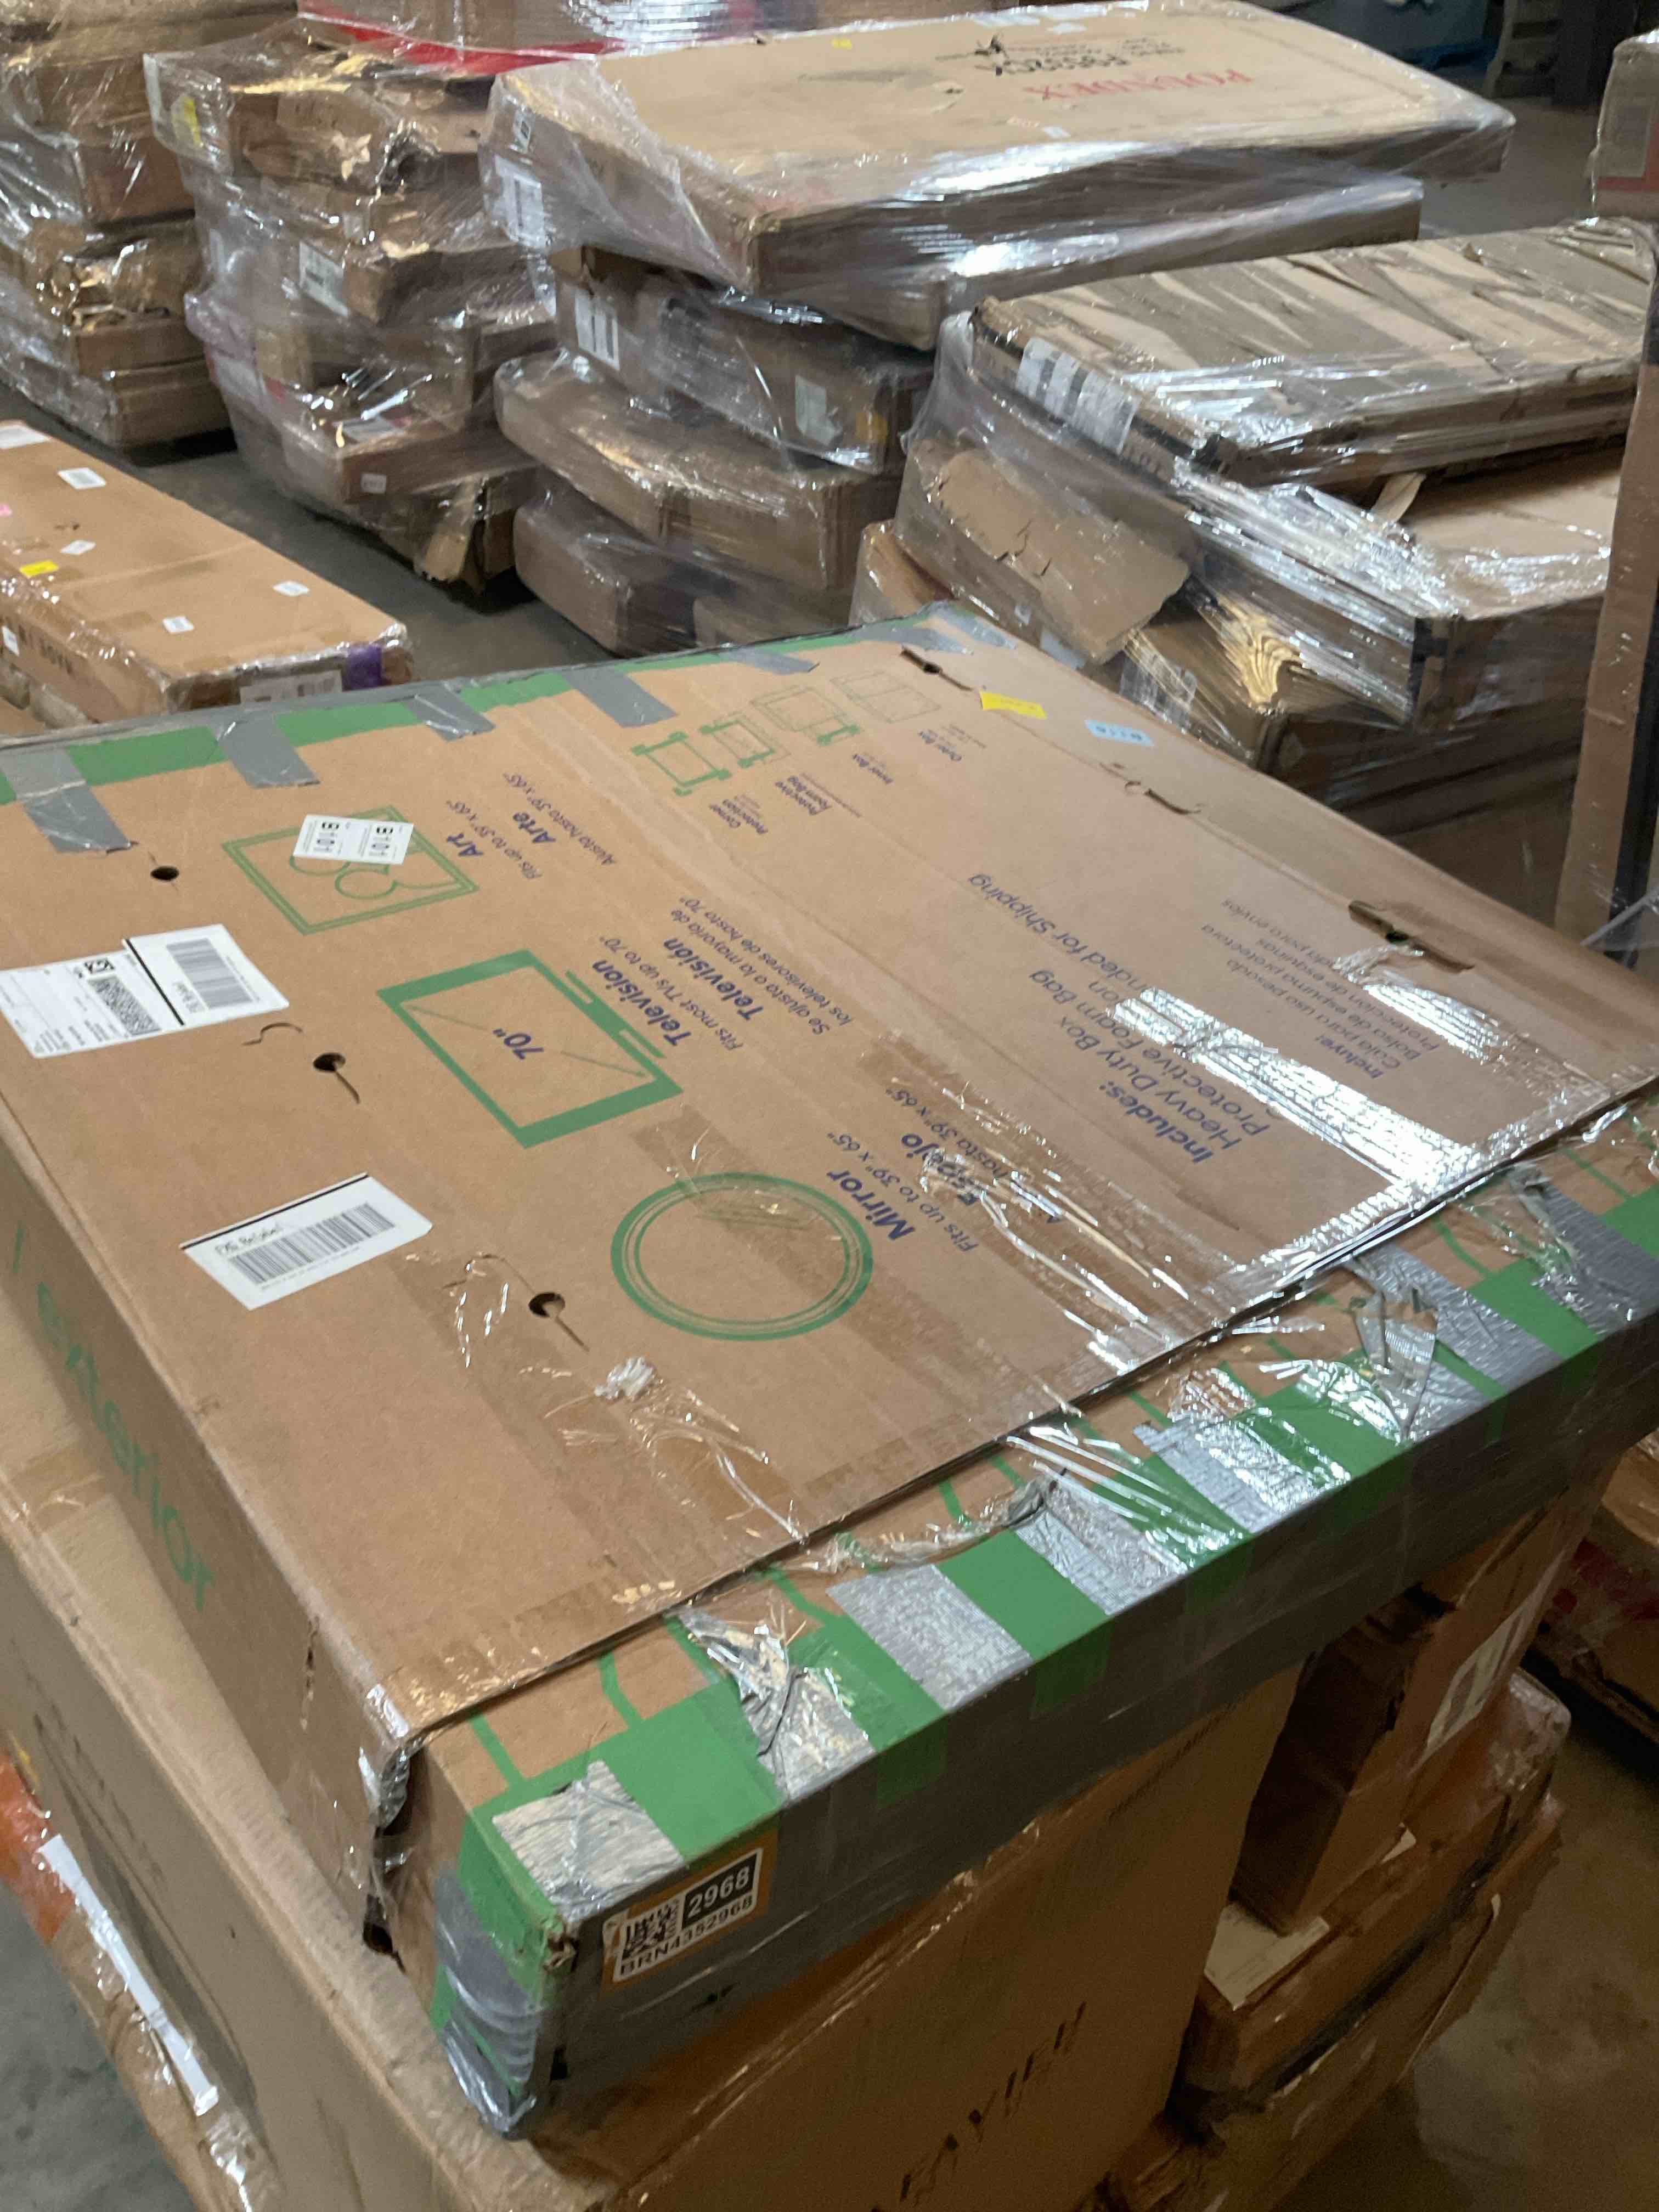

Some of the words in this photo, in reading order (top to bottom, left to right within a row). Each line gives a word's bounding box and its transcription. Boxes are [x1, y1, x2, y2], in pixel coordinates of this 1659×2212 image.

[512, 812, 556, 844] Arte
[445, 832, 484, 857] Art
[679, 898, 704, 914] 70"
[968, 873, 1057, 935] Shipping
[670, 910, 691, 923] de
[703, 912, 743, 941] hasta
[599, 936, 628, 953] 70"
[740, 939, 761, 953] de
[1053, 933, 1088, 955] for
[624, 951, 642, 966] to
[639, 963, 661, 980] up
[663, 938, 764, 1022] Televisión
[738, 963, 757, 978] la
[753, 974, 768, 984] a
[758, 952, 831, 1008] televisores
[656, 979, 682, 1003] TVs
[1028, 970, 1077, 1005] Bag
[591, 960, 691, 1047] Television
[765, 983, 811, 1017] ajusta
[679, 1000, 719, 1029] most
[808, 1017, 831, 1035] Se
[828, 1006, 853, 1026] los
[493, 1028, 544, 1060] 70"
[714, 1028, 744, 1051] Fits
[1060, 1016, 1102, 1051] Box
[1096, 1049, 1160, 1092] Duty
[885, 1088, 918, 1107] 65"
[1142, 1048, 1271, 1137] Protective
[917, 1106, 927, 1117] x
[1098, 1081, 1215, 1164] Includes:
[1154, 1090, 1242, 1150] Heavy
[826, 1132, 861, 1151] 65"
[924, 1119, 958, 1141] 39"
[858, 1151, 869, 1162] x
[865, 1165, 901, 1188] 39"
[826, 1170, 916, 1241] Mirror
[899, 1186, 919, 1204] to
[918, 1203, 946, 1223] up
[943, 1223, 979, 1252] Fits
[687, 1866, 750, 1918] 2968
